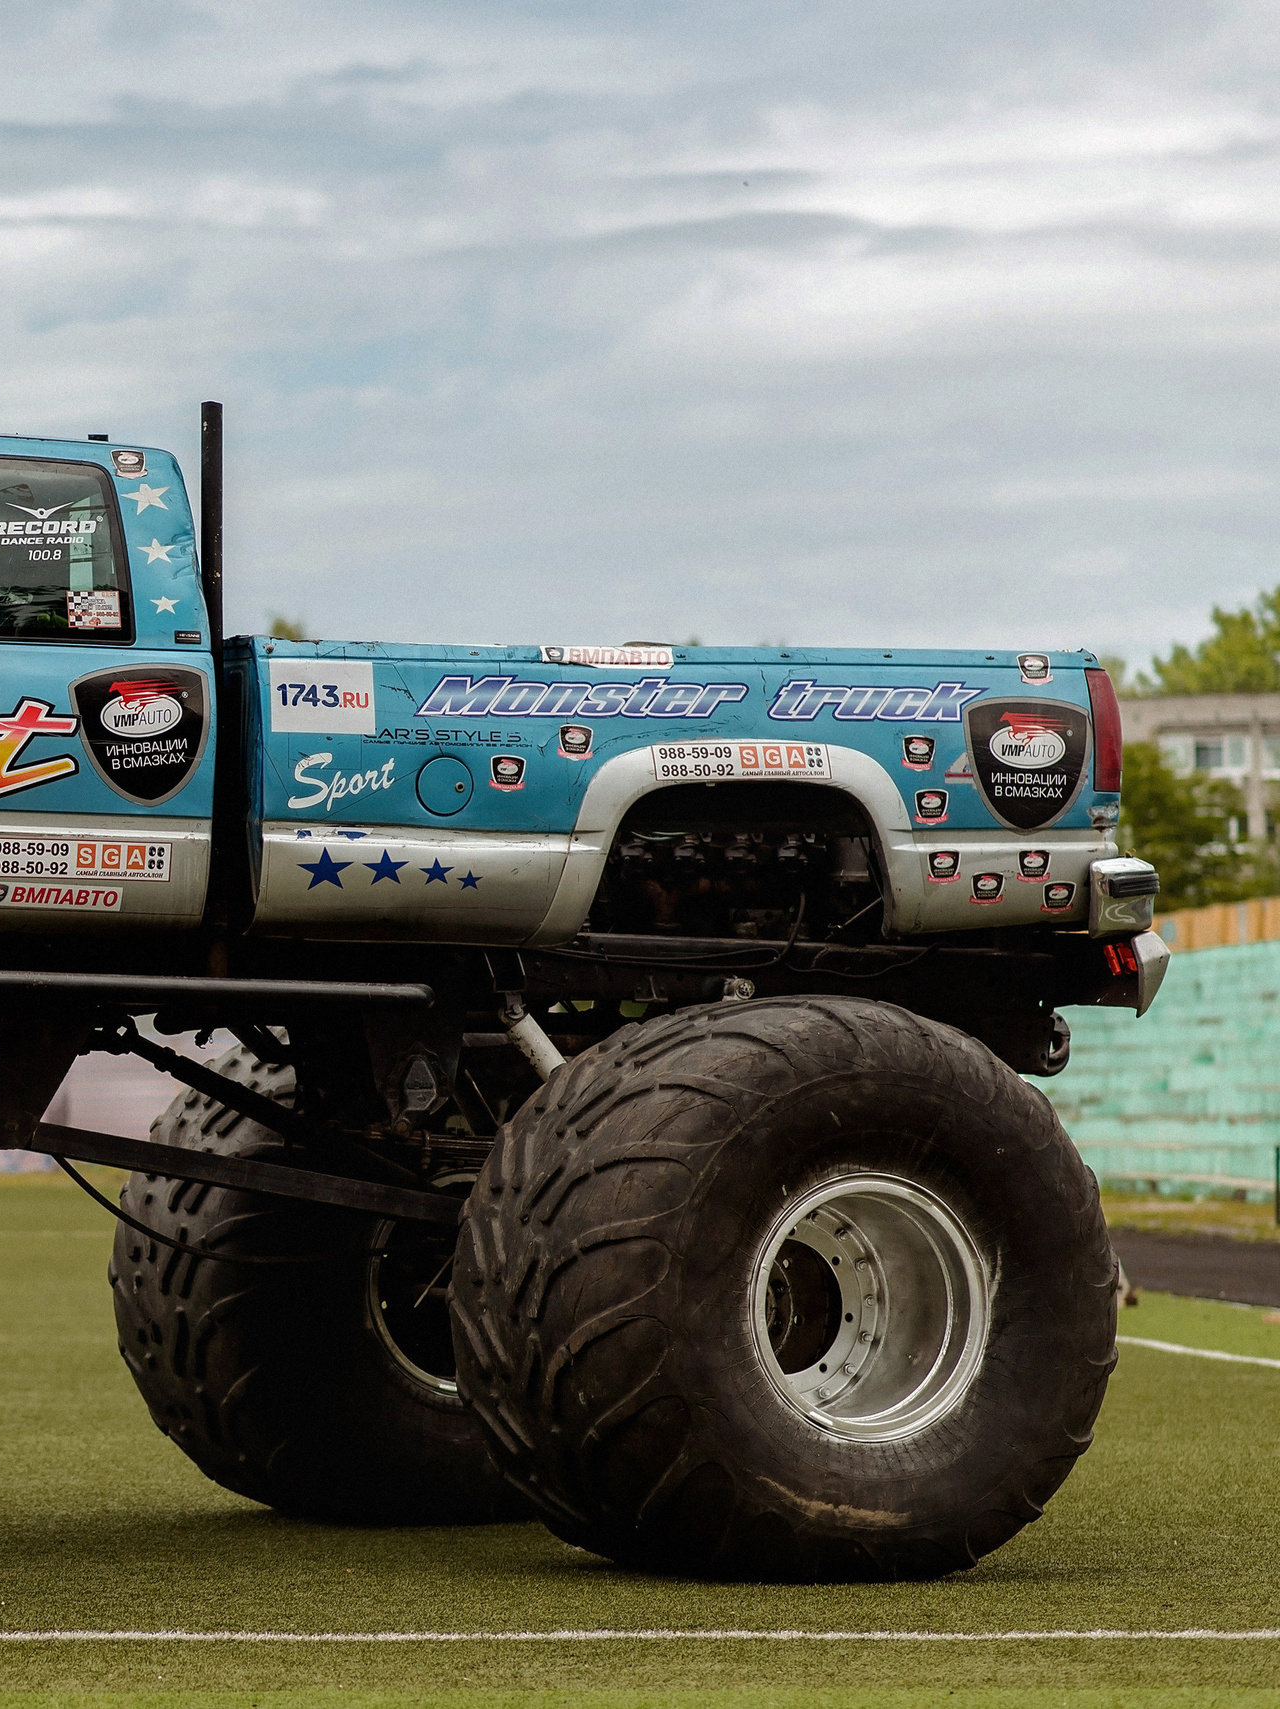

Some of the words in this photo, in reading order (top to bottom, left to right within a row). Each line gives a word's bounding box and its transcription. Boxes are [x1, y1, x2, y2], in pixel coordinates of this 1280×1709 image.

[1, 537, 44, 545] DANCE
[46, 536, 84, 545] RADIO
[28, 550, 62, 561] 100.8
[569, 648, 670, 666] ВМПАВТО
[276, 683, 369, 708] 1743.RU
[415, 674, 748, 719] Monster
[767, 680, 988, 722] truck
[114, 709, 172, 727] VMPAUTO
[436, 730, 501, 742] STYLE
[106, 738, 188, 757] ИННОВАЦИИ
[659, 746, 732, 759] 988-59-09
[1001, 744, 1056, 758] VMPAUTO
[112, 759, 121, 770] В
[123, 752, 186, 769] СМАЗКАХ
[743, 749, 805, 765] SGA
[661, 764, 734, 776] 988-50-92
[287, 753, 395, 811] Sport
[991, 772, 1067, 787] ИННОВАЦИИ
[995, 786, 1002, 797] В
[1005, 786, 1063, 798] СМАЗКАХ
[78, 847, 144, 866] SGA
[11, 886, 118, 907] ВМПАВТО
